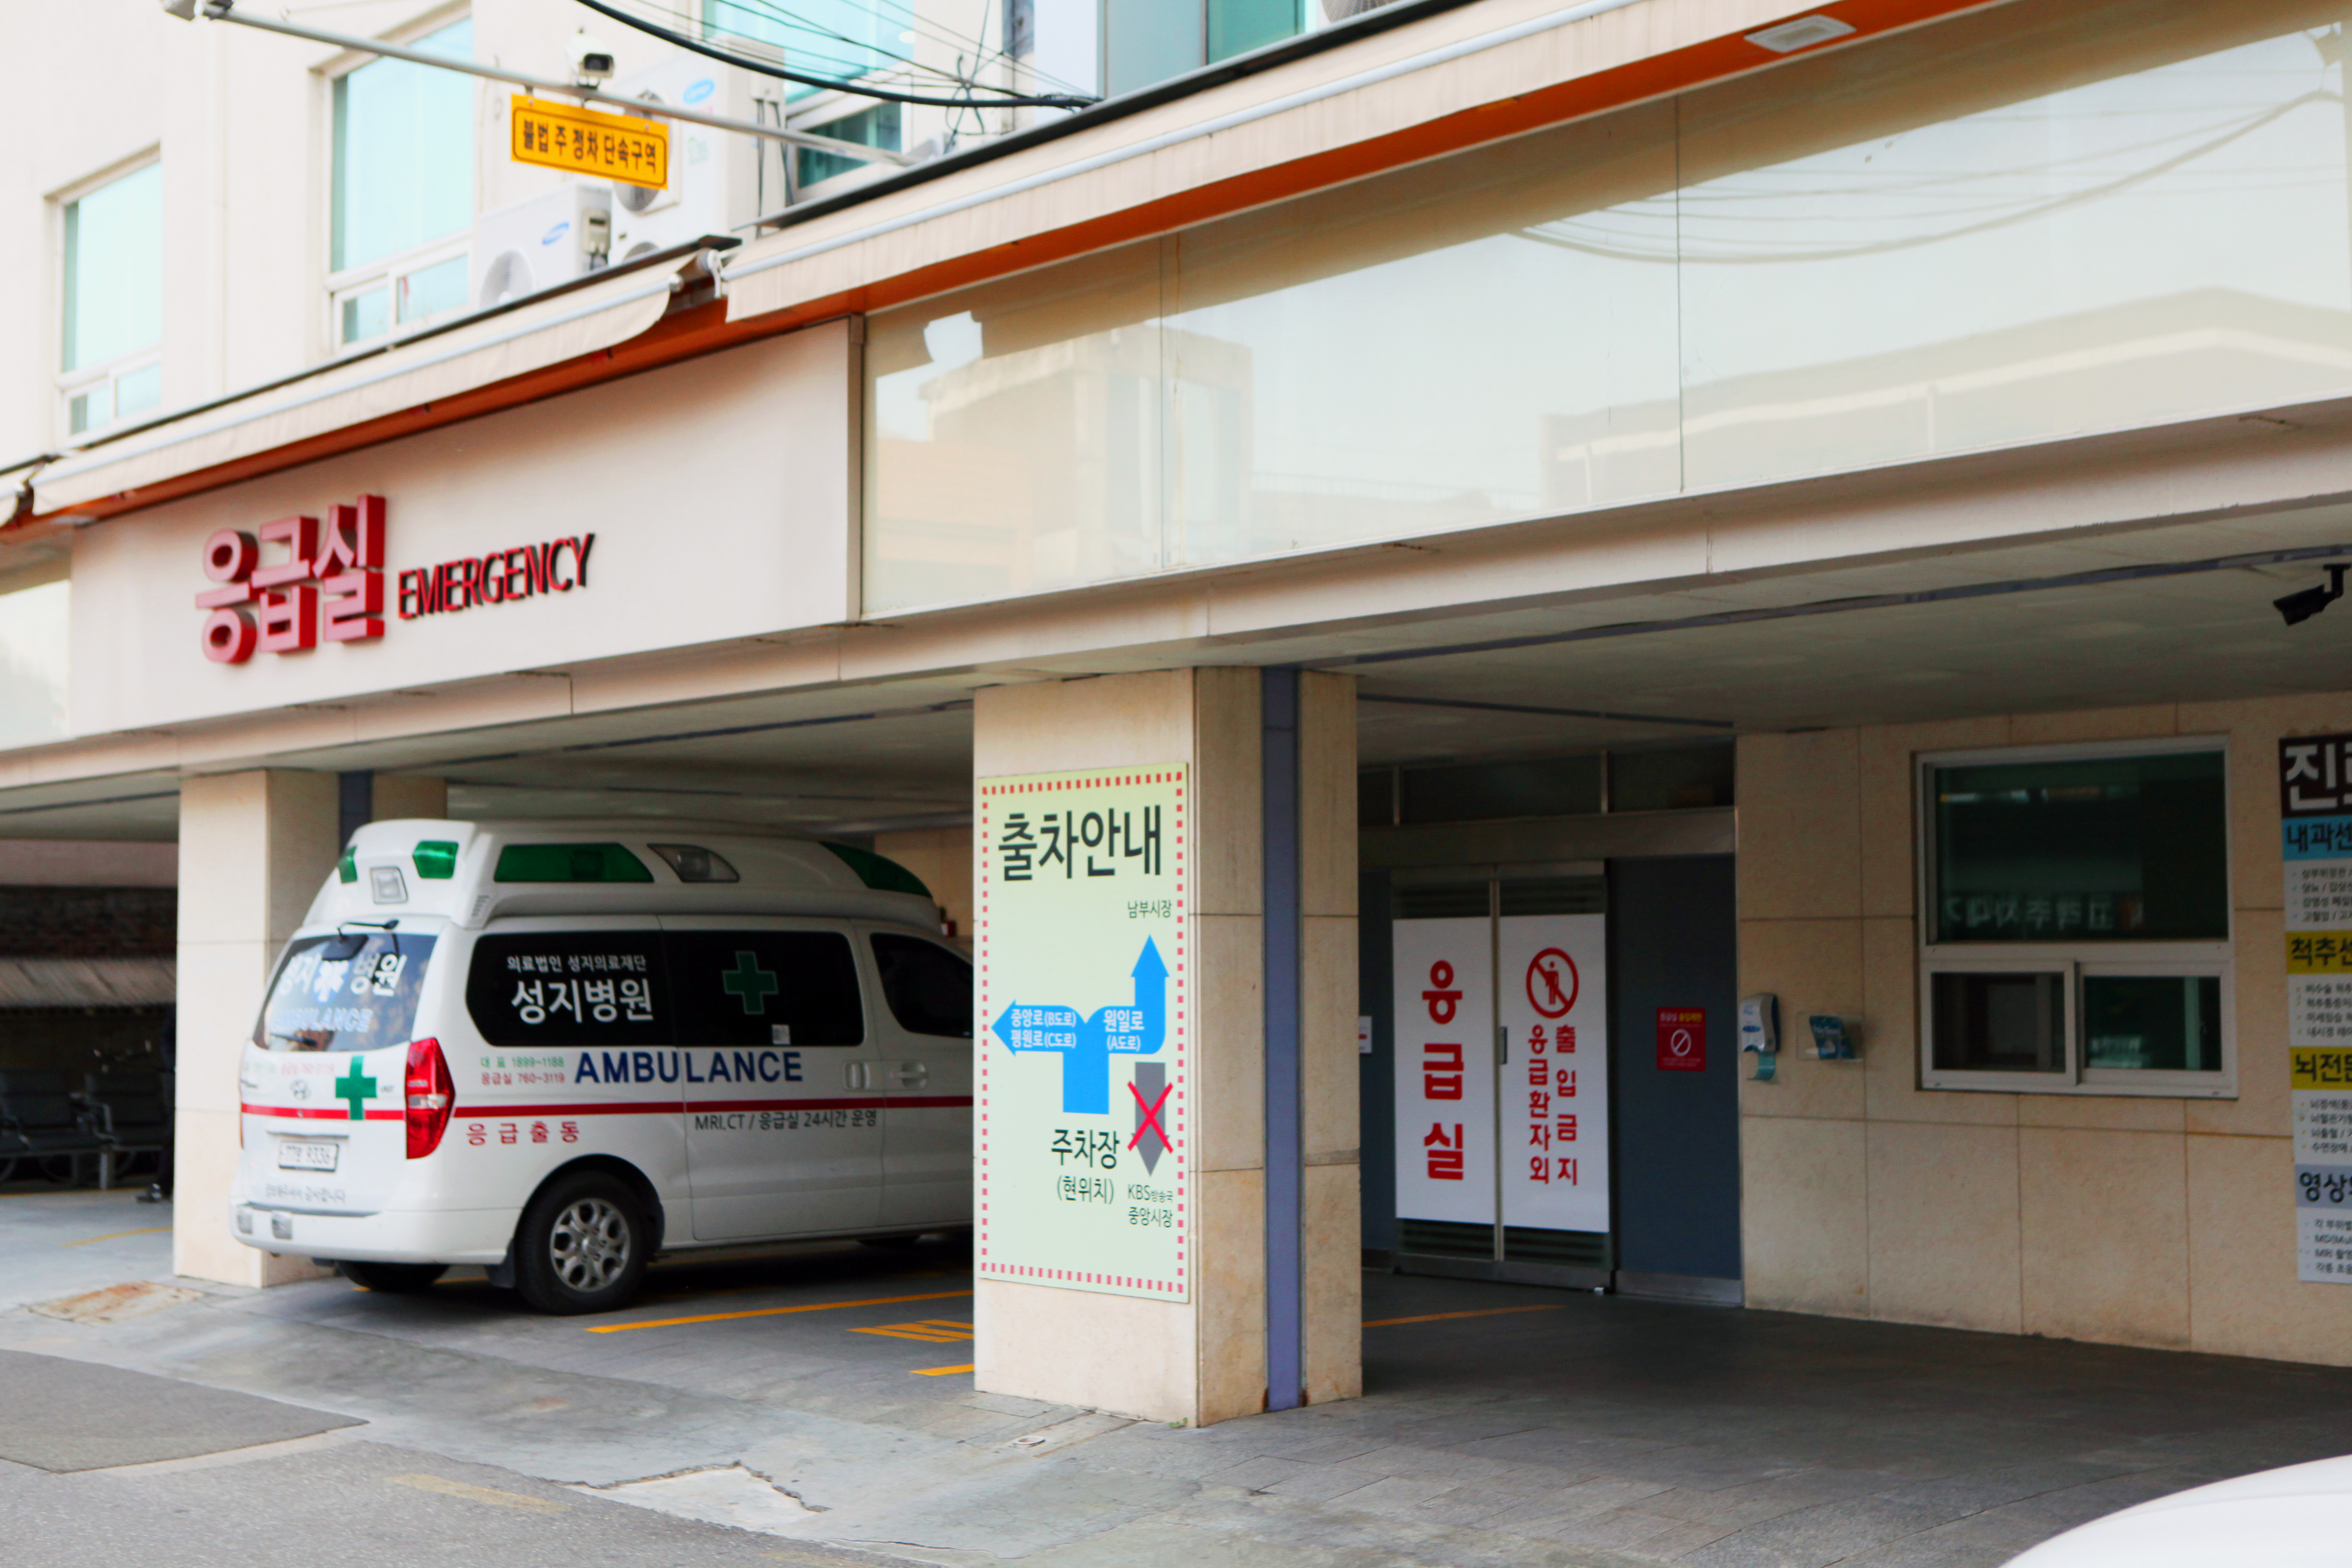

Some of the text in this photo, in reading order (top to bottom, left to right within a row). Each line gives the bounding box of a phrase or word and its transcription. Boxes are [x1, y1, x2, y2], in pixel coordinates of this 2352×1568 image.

[524, 120, 549, 153] 불법
[604, 134, 656, 175] 단속구역
[196, 493, 386, 665] 응급실
[398, 533, 595, 619] EMERGENCY
[2285, 741, 2352, 812] 진
[998, 804, 1161, 882] 출차안내
[1127, 899, 1172, 918] 남부시장
[351, 953, 407, 997] 병원
[507, 954, 647, 974] 의료법인 성지의료재단
[511, 978, 654, 1025] 성지병원
[273, 1008, 374, 1033] AMBULANCE
[1103, 1009, 1145, 1032] 원일로
[1106, 1034, 1141, 1052] (A도로)
[481, 1071, 512, 1086] 응급실
[574, 1050, 803, 1084] AMBULANCE
[1422, 959, 1464, 1181] 응급실
[758, 1111, 799, 1130] 응급실
[803, 1109, 848, 1128] 24시간
[851, 1108, 878, 1127] 운영
[1556, 1024, 1578, 1186] 출입금지
[1051, 1129, 1120, 1169] 주차장
[1057, 1175, 1115, 1205] (현위치)
[2299, 1171, 2352, 1203] 영상
[1128, 1206, 1173, 1228] 중앙시장
